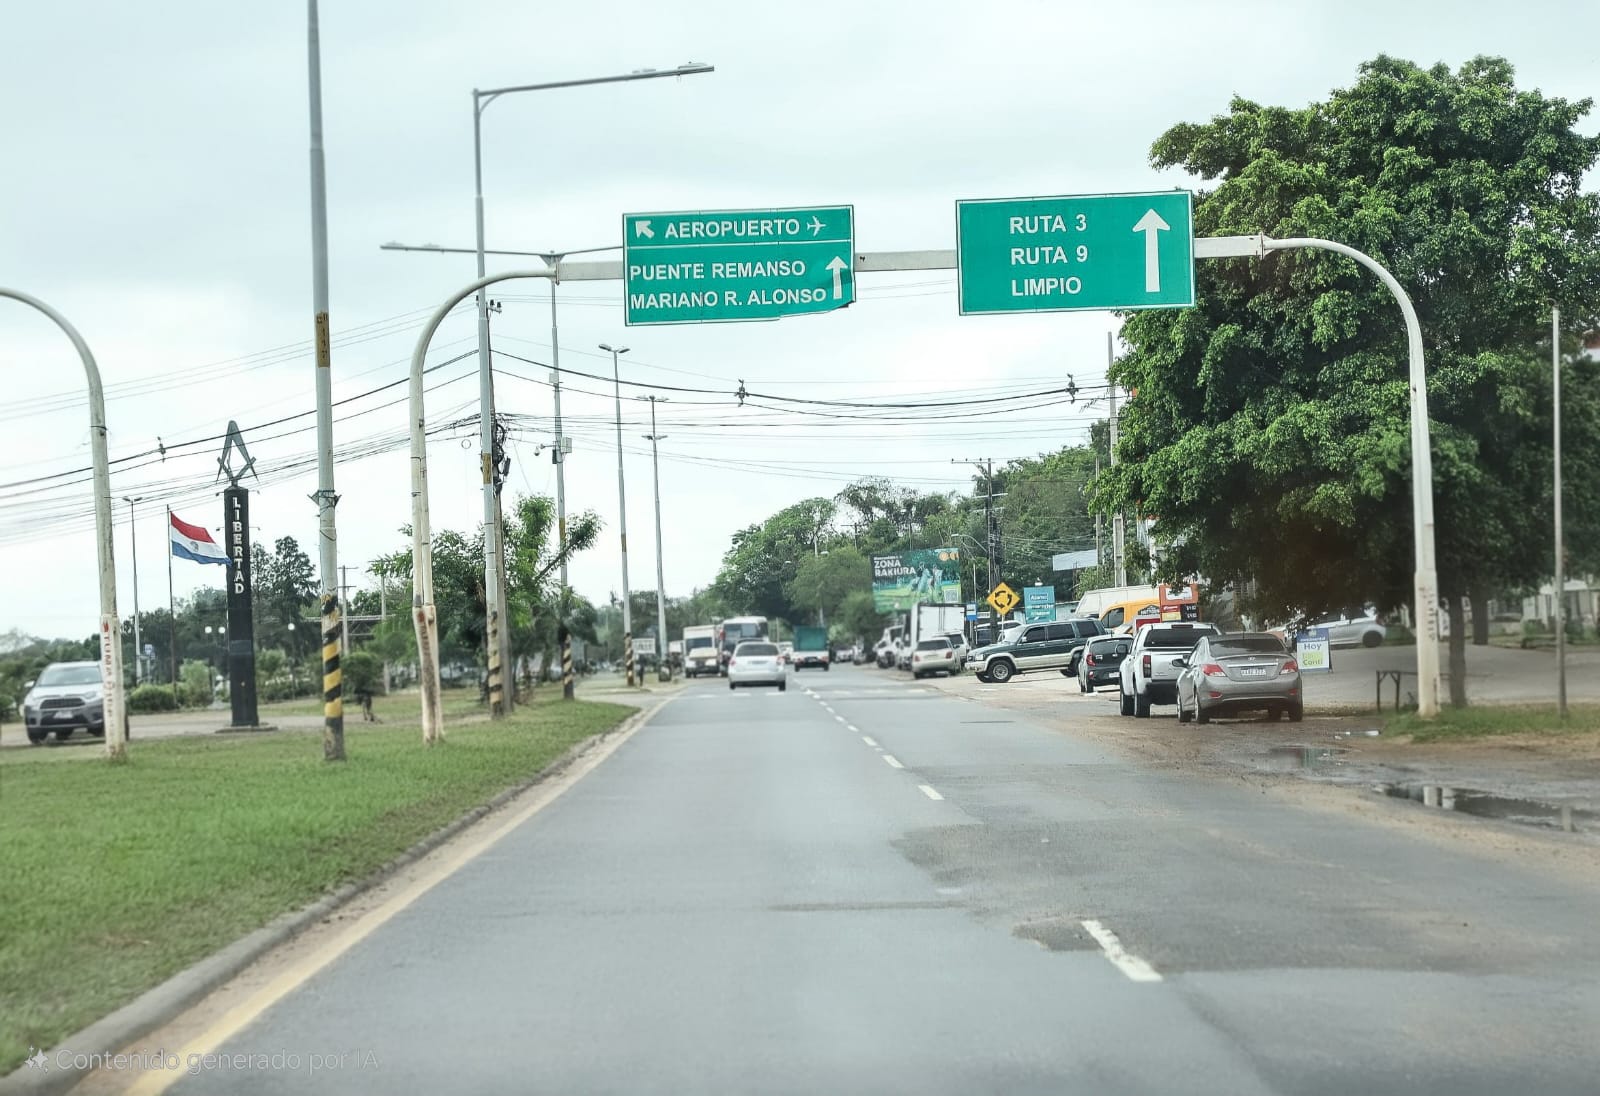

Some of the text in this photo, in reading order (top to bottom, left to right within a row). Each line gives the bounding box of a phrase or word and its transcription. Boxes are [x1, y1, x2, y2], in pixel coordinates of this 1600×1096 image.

[665, 218, 800, 238] AEROPUERTO
[1009, 213, 1088, 234] RUTA 3
[1010, 245, 1088, 265] RUTA 9
[630, 260, 806, 281] PUENTE REMANSO
[1010, 276, 1082, 297] LIMPIO
[631, 288, 827, 309] MARIANO R. ALONSO
[232, 496, 245, 594] LIBERTAD
[874, 559, 901, 568] ZONA
[874, 566, 916, 576] RAKIURA
